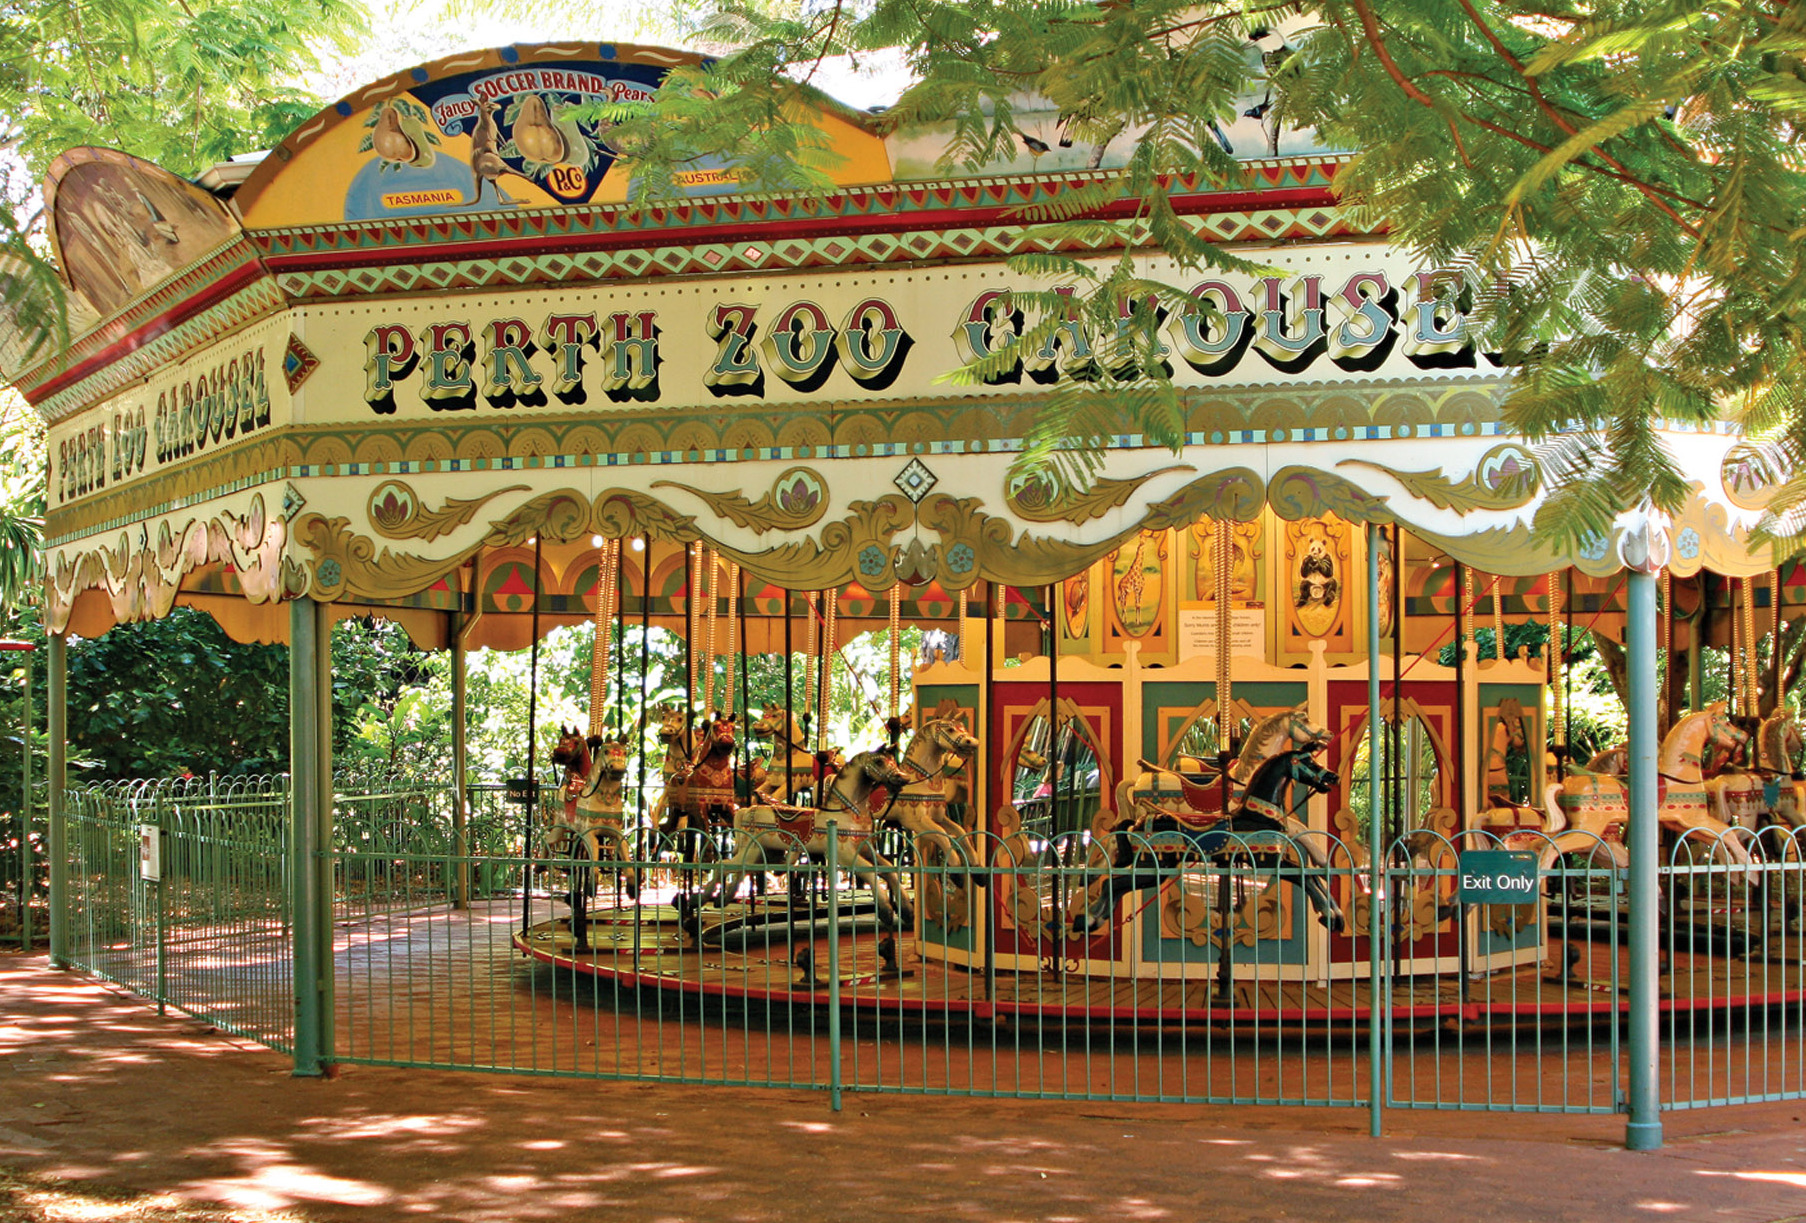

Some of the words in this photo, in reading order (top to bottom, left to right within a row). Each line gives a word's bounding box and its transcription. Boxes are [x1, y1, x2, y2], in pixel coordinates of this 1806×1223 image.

[434, 101, 475, 126] Fancy
[474, 71, 537, 102] SOCCER
[541, 70, 602, 94] BRAND
[676, 168, 754, 185] AUSTRAL
[386, 191, 456, 206] TASMANIA
[364, 309, 664, 415] PERTH
[703, 296, 915, 400] ZOO
[951, 269, 1549, 388] CAROUSE
[58, 422, 106, 503] PERTH
[112, 404, 148, 482] ZOO
[154, 345, 272, 465] CAROUSEL
[510, 790, 521, 798] No
[1462, 875, 1492, 890] Exit
[1497, 875, 1534, 893] Only
